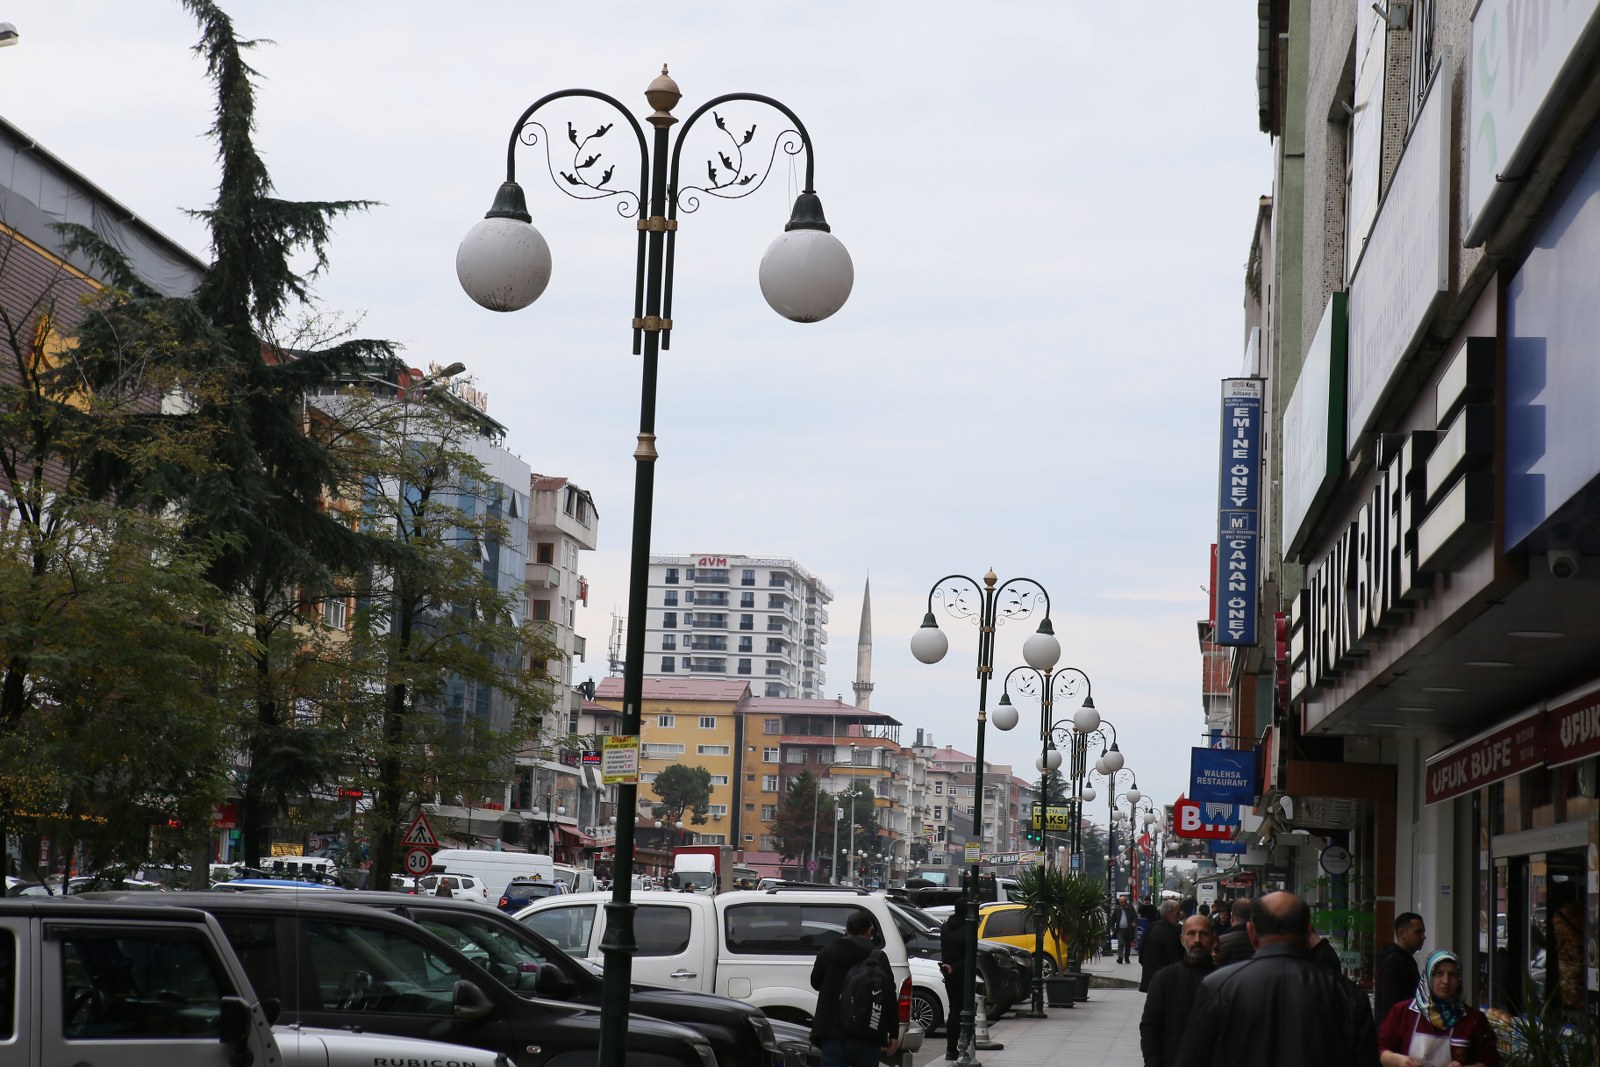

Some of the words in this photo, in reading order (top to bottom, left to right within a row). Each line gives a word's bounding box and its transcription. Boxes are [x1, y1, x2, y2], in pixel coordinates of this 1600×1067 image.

[1230, 464, 1249, 507] ÖNEY
[698, 557, 727, 567] AVM
[1228, 540, 1247, 592] CANAN
[1308, 523, 1351, 689] UFUK
[1357, 431, 1412, 642] BÜFE
[1228, 597, 1246, 640] ÖNEY
[1560, 703, 1600, 749] UFUK
[1197, 777, 1248, 787] RESTAURANT
[1204, 769, 1241, 779] WALENSA
[1432, 757, 1467, 796] UFUK
[1471, 738, 1512, 780] BÜFE
[410, 856, 427, 868] 30
[869, 1002, 882, 1030] NIKE
[373, 1057, 477, 1067] RUBICON
